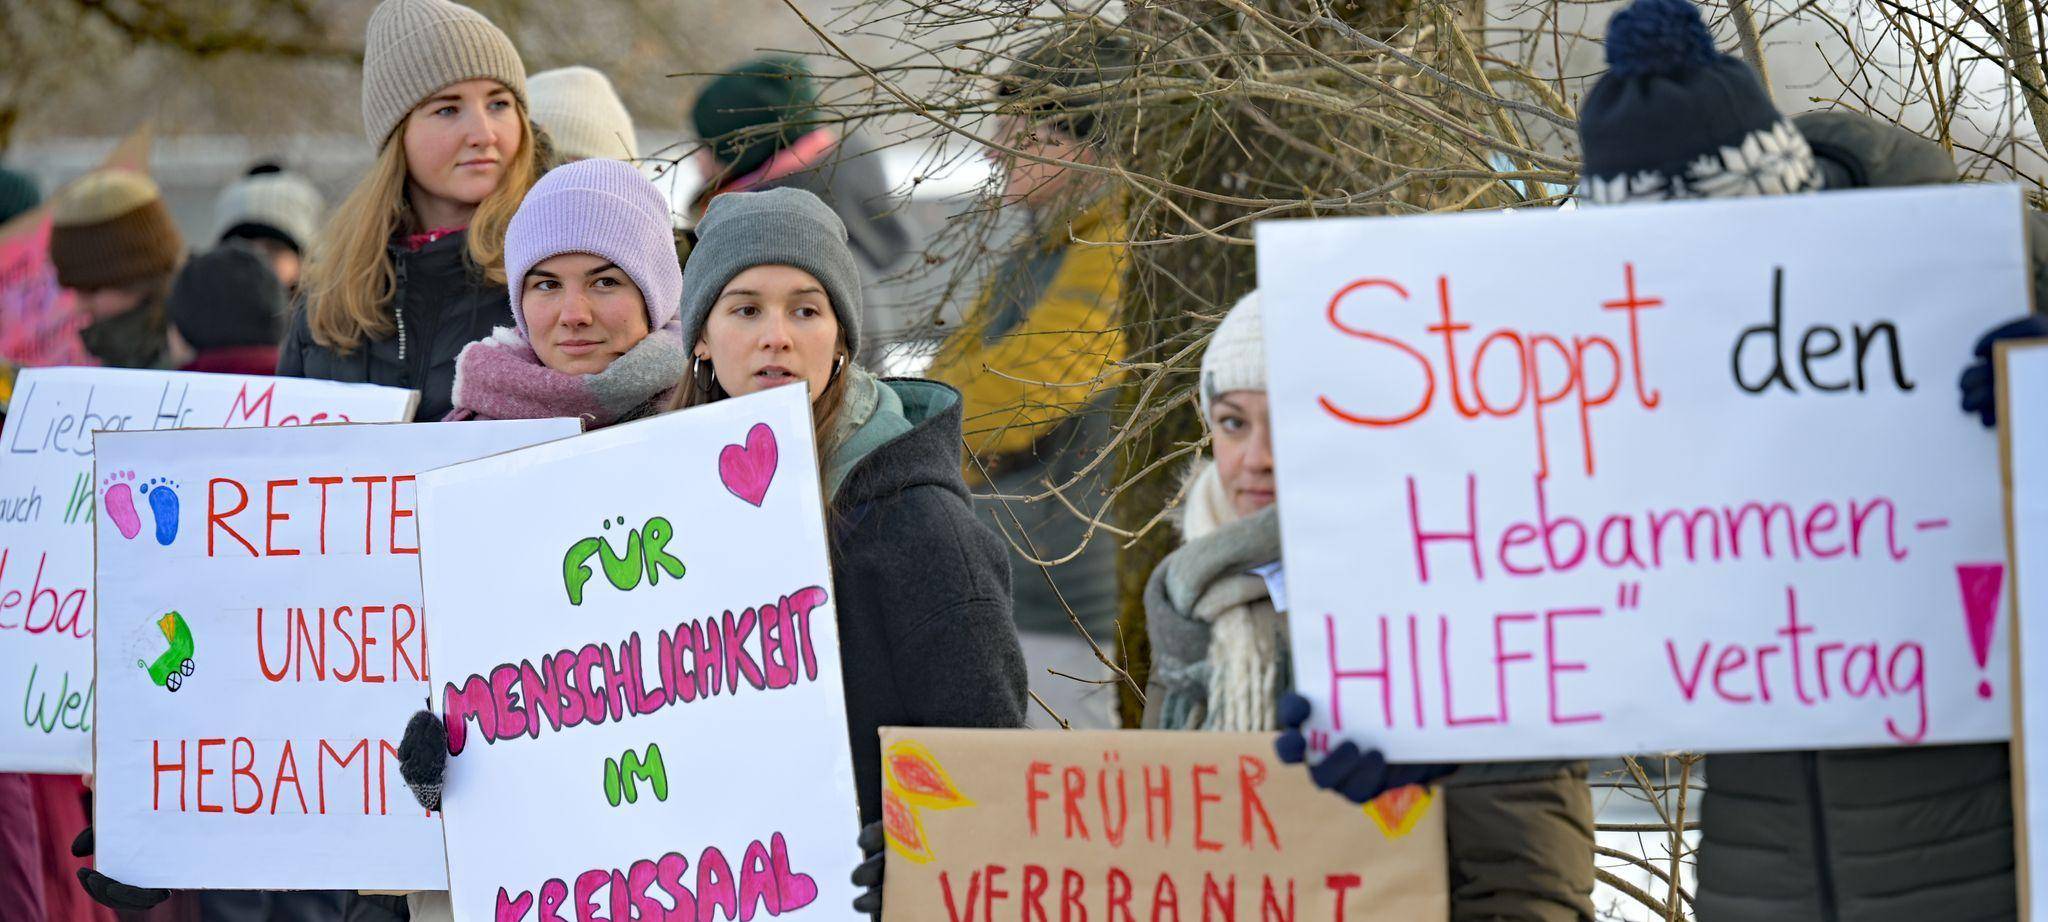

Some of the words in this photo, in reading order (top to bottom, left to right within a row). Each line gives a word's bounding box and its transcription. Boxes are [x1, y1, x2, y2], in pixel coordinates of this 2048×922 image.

[1319, 263, 1662, 477] Stoppt
[1732, 267, 1915, 394] den
[208, 475, 419, 558] RETTE
[562, 516, 686, 606] FÜR
[1406, 472, 1949, 583] Hebammen-
[443, 586, 829, 757] MENSCHLICHKEIT
[603, 742, 669, 807] IM
[1024, 751, 1281, 852] FRÜHER
